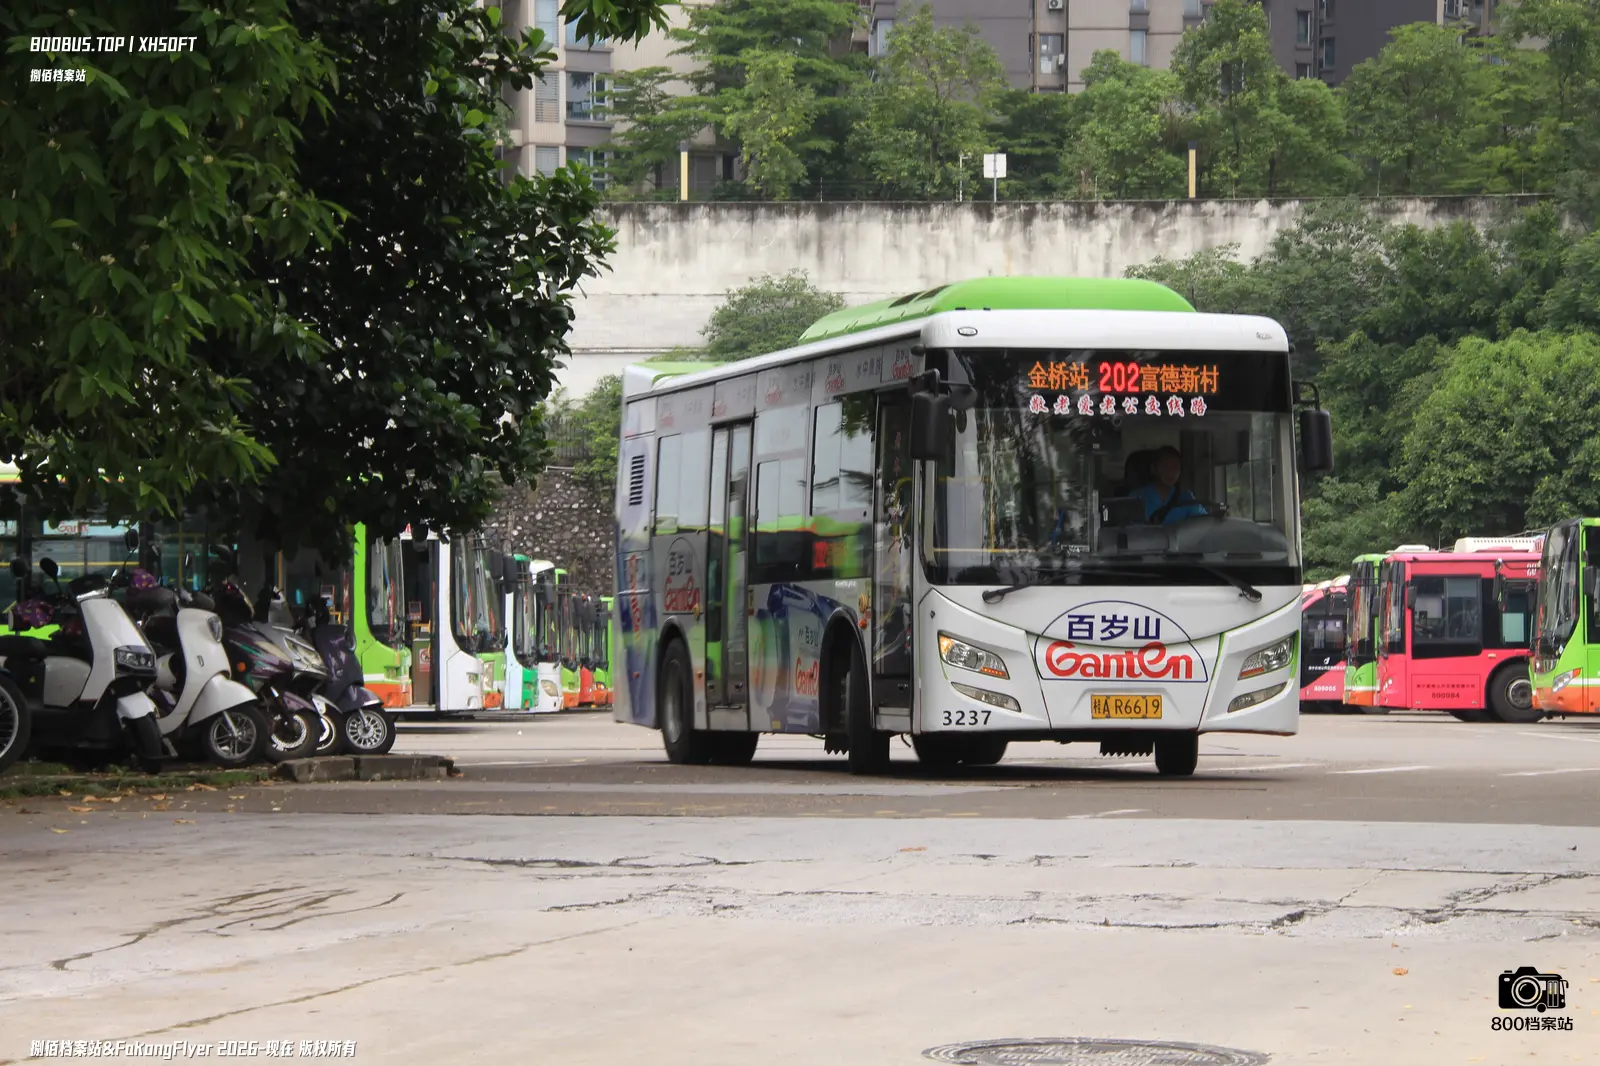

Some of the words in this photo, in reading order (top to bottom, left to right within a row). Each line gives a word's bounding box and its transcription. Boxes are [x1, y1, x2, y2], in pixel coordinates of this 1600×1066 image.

[1028, 361, 1089, 391] 金桥站
[1099, 362, 1140, 392] 202
[1140, 364, 1219, 393] 富德新村
[1067, 614, 1161, 641] 百岁山
[1045, 641, 1193, 680] Ganten
[942, 710, 992, 726] 3237
